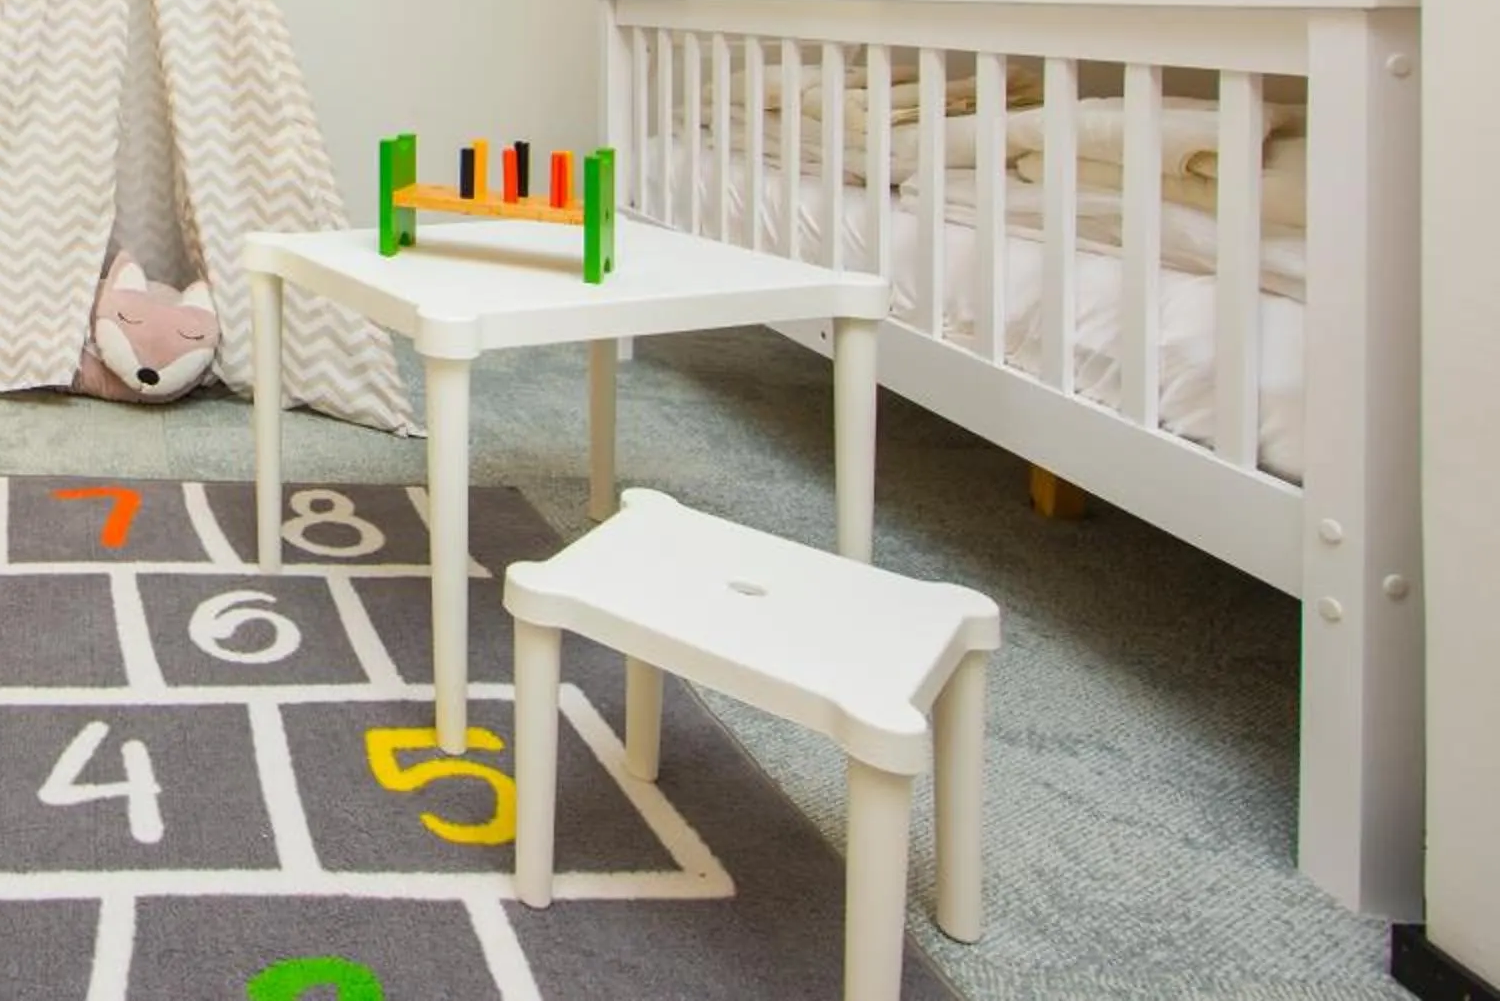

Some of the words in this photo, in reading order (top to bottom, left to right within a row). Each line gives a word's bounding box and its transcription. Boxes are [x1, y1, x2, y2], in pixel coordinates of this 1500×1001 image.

[53, 486, 142, 548] 7
[281, 489, 386, 557] 8
[188, 590, 302, 664] 6
[37, 721, 165, 844] 4
[364, 725, 517, 847] 5
